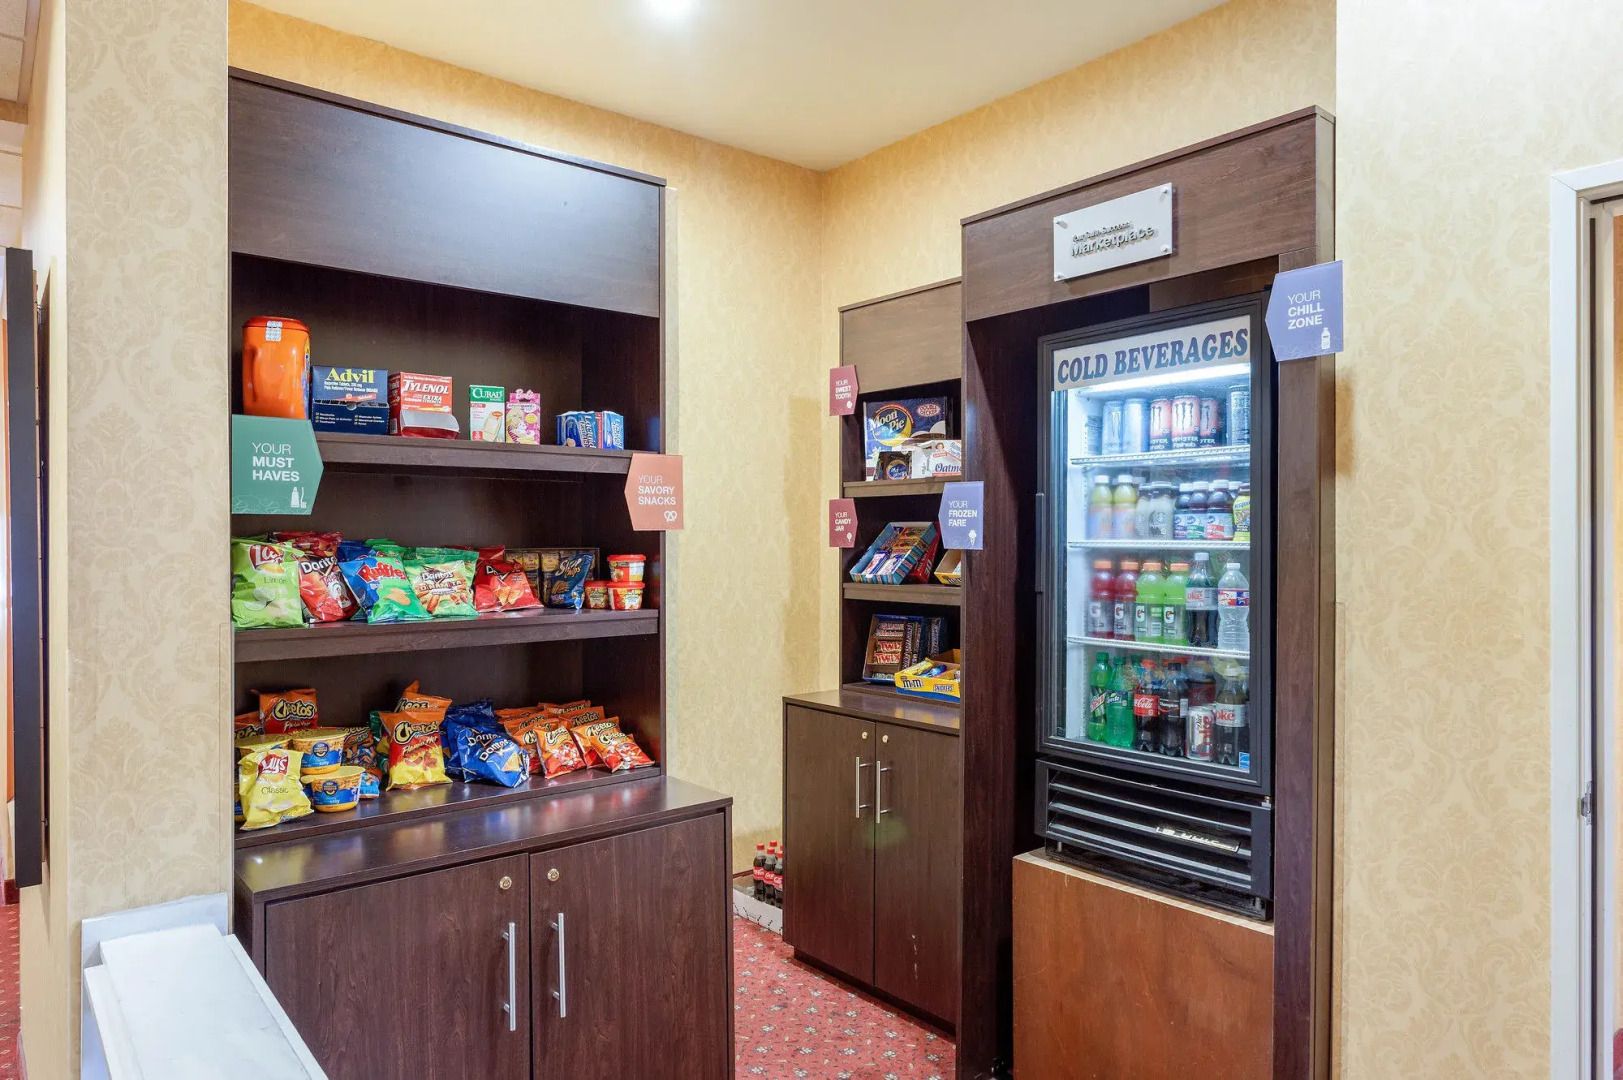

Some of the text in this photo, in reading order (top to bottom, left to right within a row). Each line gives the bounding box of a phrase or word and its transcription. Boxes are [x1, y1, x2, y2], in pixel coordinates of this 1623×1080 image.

[1071, 226, 1155, 257] Marketplace
[1287, 289, 1321, 305] YOUR
[1287, 302, 1325, 317] CHILL
[1287, 314, 1323, 330] ZONE
[1057, 328, 1249, 384] COLD BEVERAGES
[325, 367, 375, 384] Advil
[401, 379, 450, 395] TYLENOL
[472, 387, 503, 400] CURAD
[835, 385, 852, 394] SWEET
[869, 410, 898, 432] Moon
[888, 418, 905, 434] Pie
[252, 442, 292, 455] YOUR
[252, 455, 295, 468] MUST
[252, 469, 300, 482] HAVES
[637, 475, 663, 484] YOUR
[637, 485, 676, 495] SAVORY
[637, 496, 677, 506] SNACKS
[948, 500, 968, 508] YOUR
[834, 511, 848, 519] YOUR
[948, 509, 978, 518] FROZEN
[948, 519, 967, 527] FARE
[934, 684, 954, 692] SNICKERS
[274, 699, 314, 720] Cheetos
[394, 721, 439, 744] Cheetos
[261, 786, 289, 795] Classic
